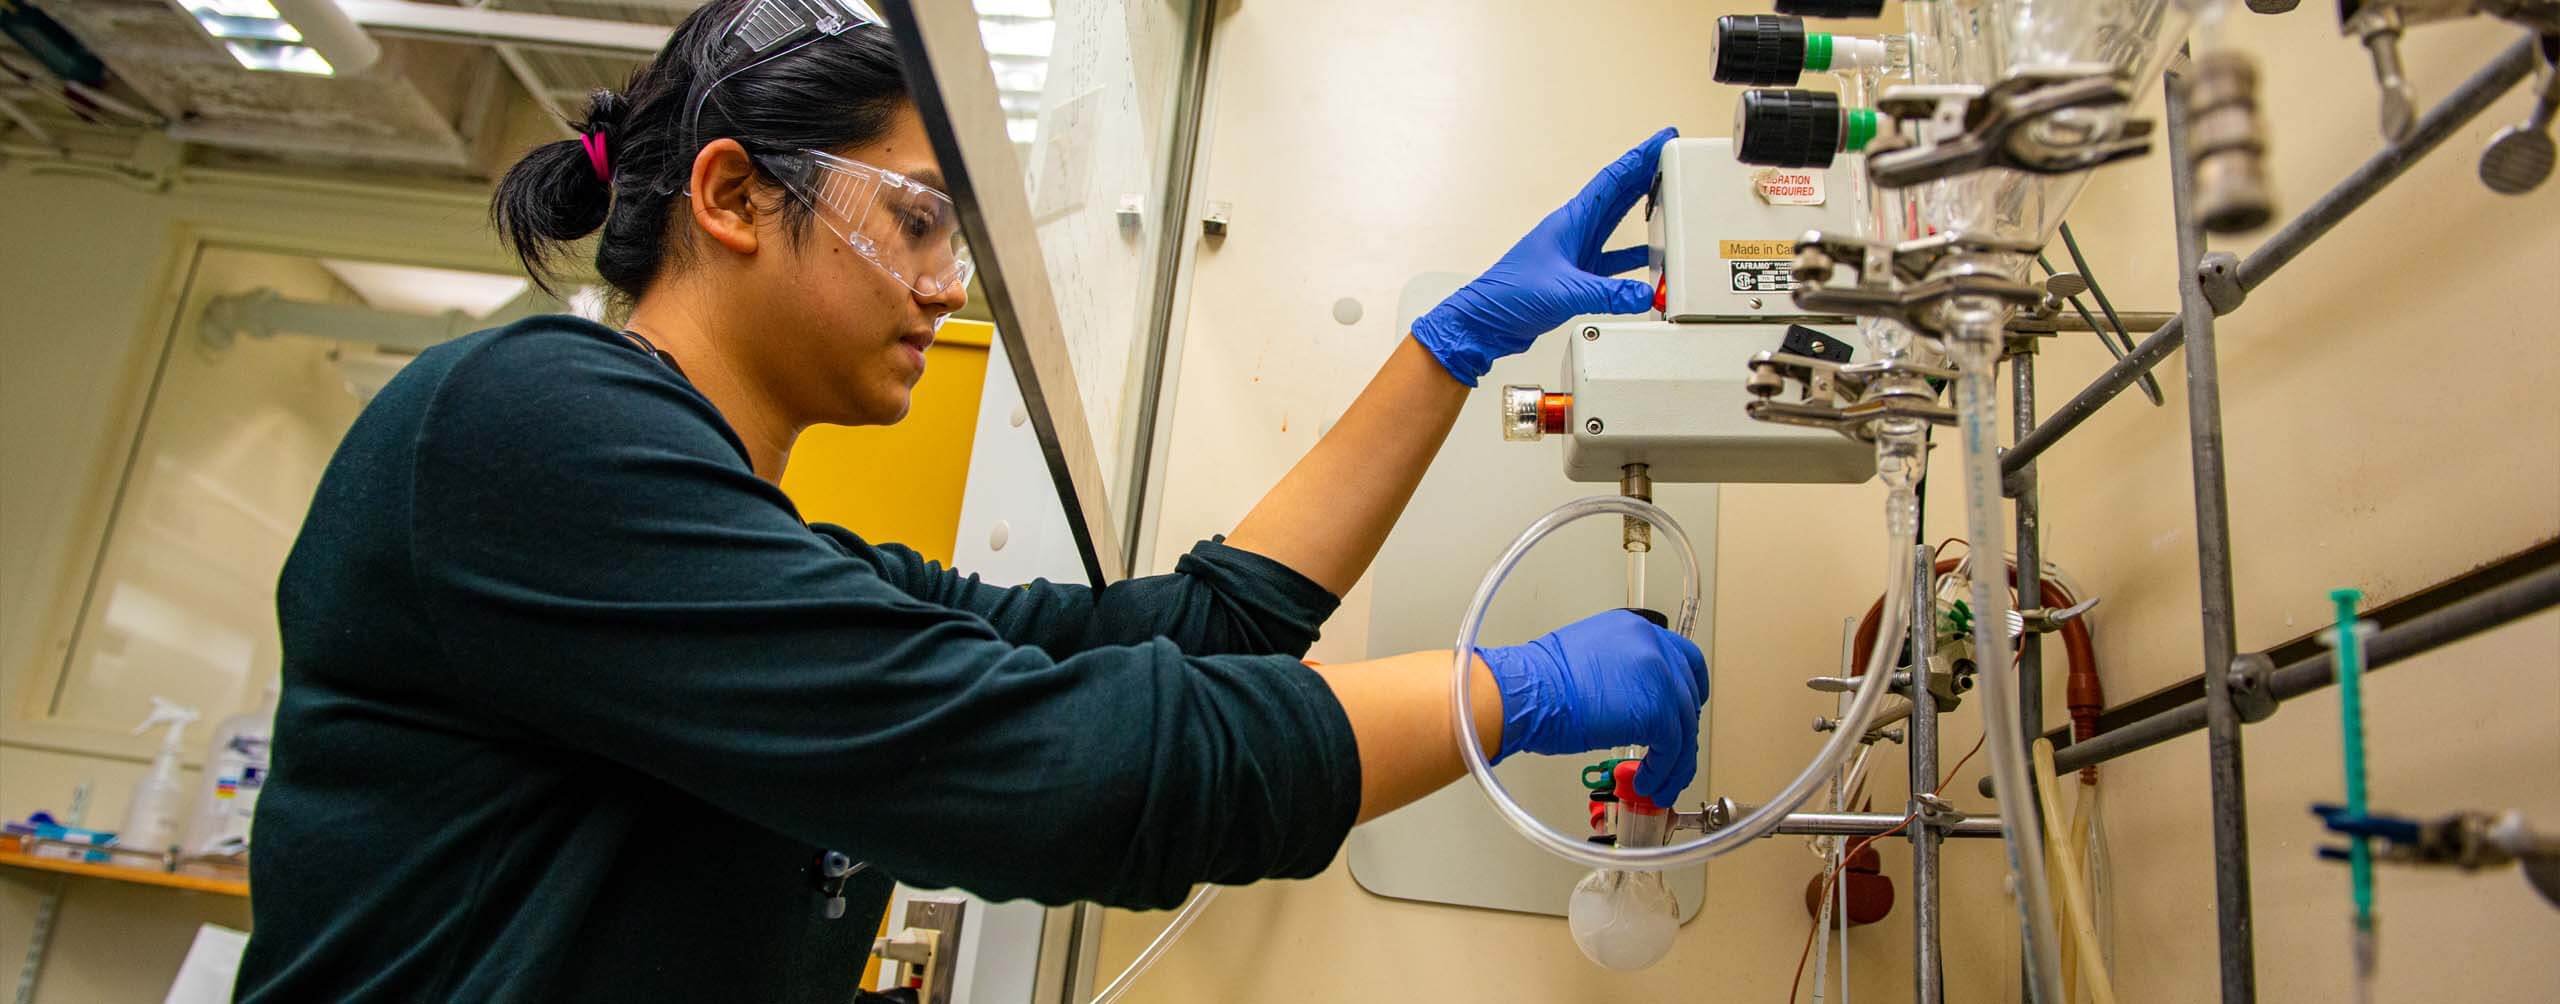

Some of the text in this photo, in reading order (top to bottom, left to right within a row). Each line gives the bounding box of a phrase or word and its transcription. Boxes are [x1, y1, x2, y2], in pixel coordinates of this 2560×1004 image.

[1769, 186, 1815, 196] REQUIRED
[1730, 243, 1760, 255] Made
[1763, 243, 1773, 255] in
